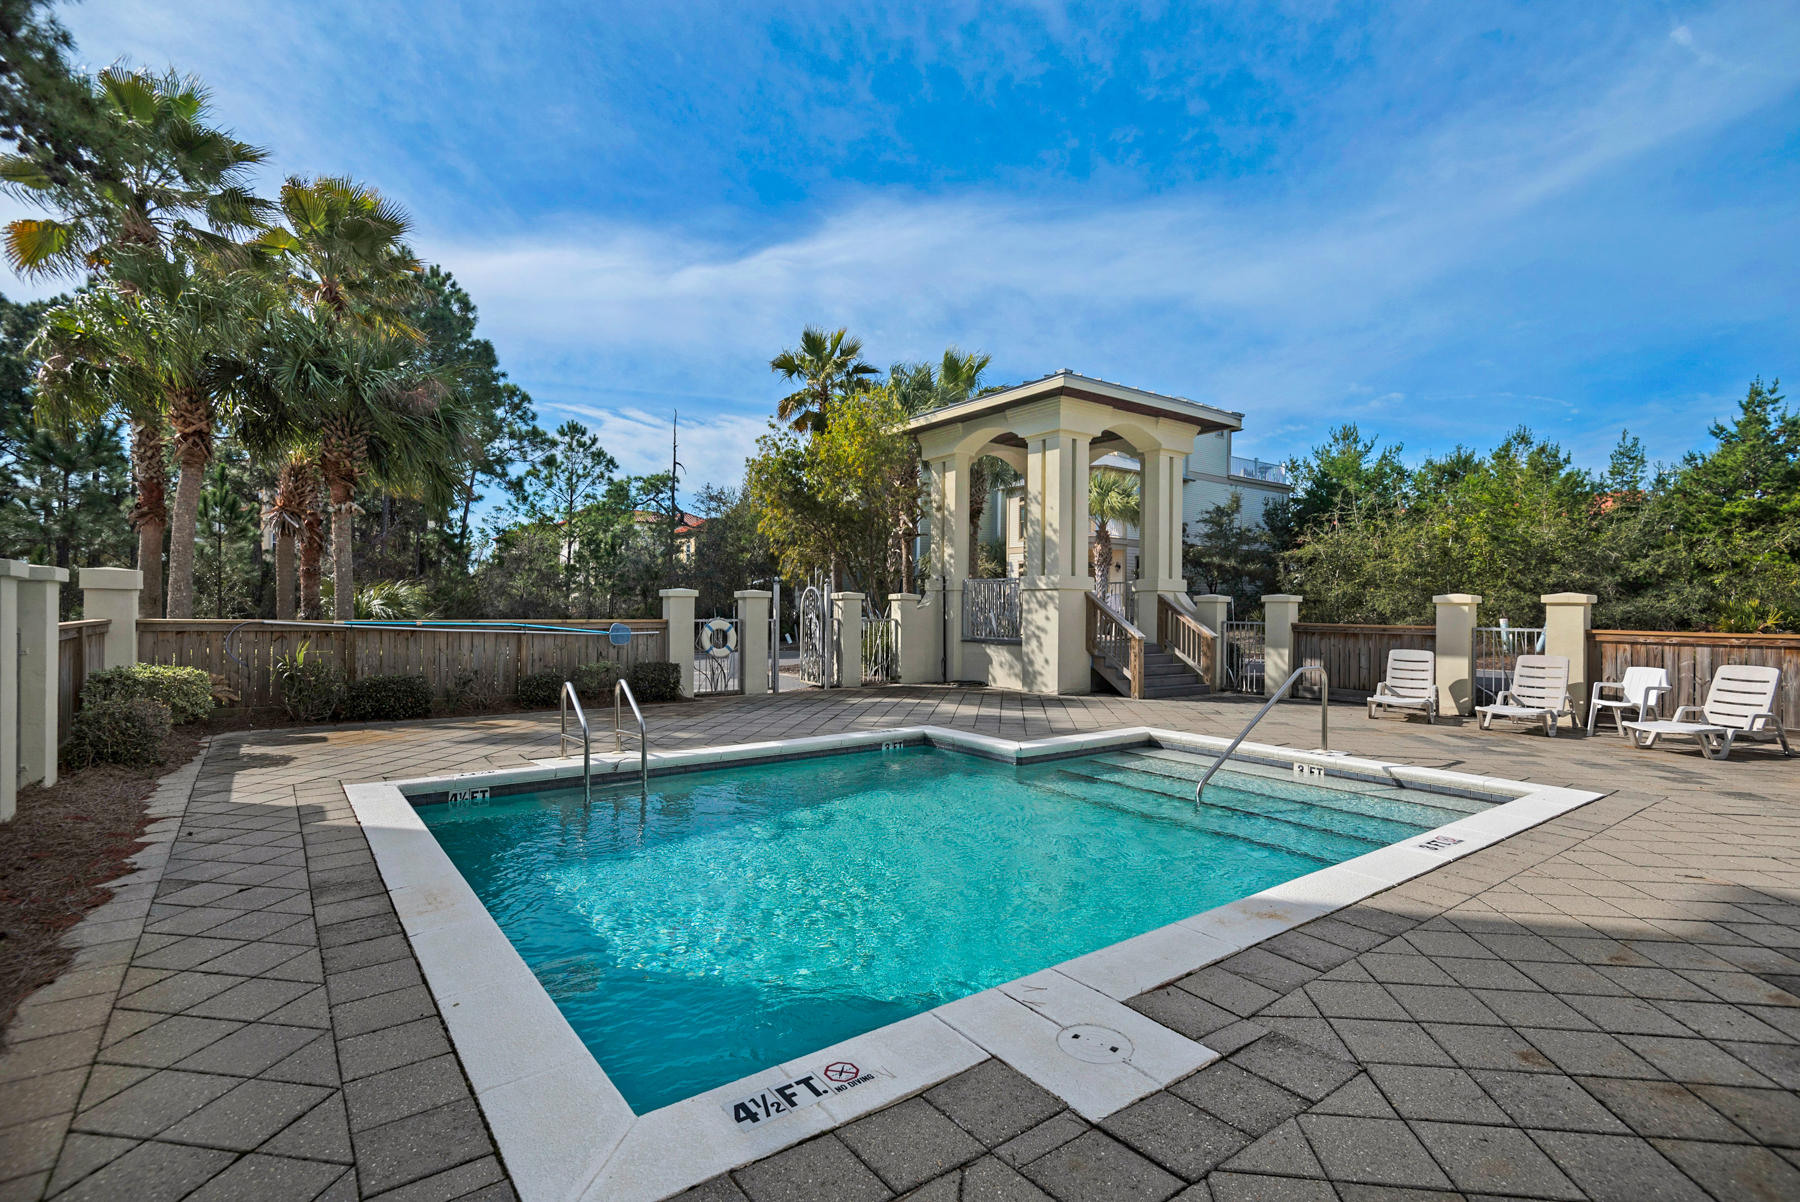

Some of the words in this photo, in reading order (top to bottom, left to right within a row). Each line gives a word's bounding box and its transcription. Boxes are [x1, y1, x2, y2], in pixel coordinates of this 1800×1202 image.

[1309, 766, 1324, 775] FT
[470, 789, 489, 801] FT
[834, 1084, 848, 1093] NO
[849, 1073, 875, 1088] DIVING
[774, 1075, 829, 1109] FT.
